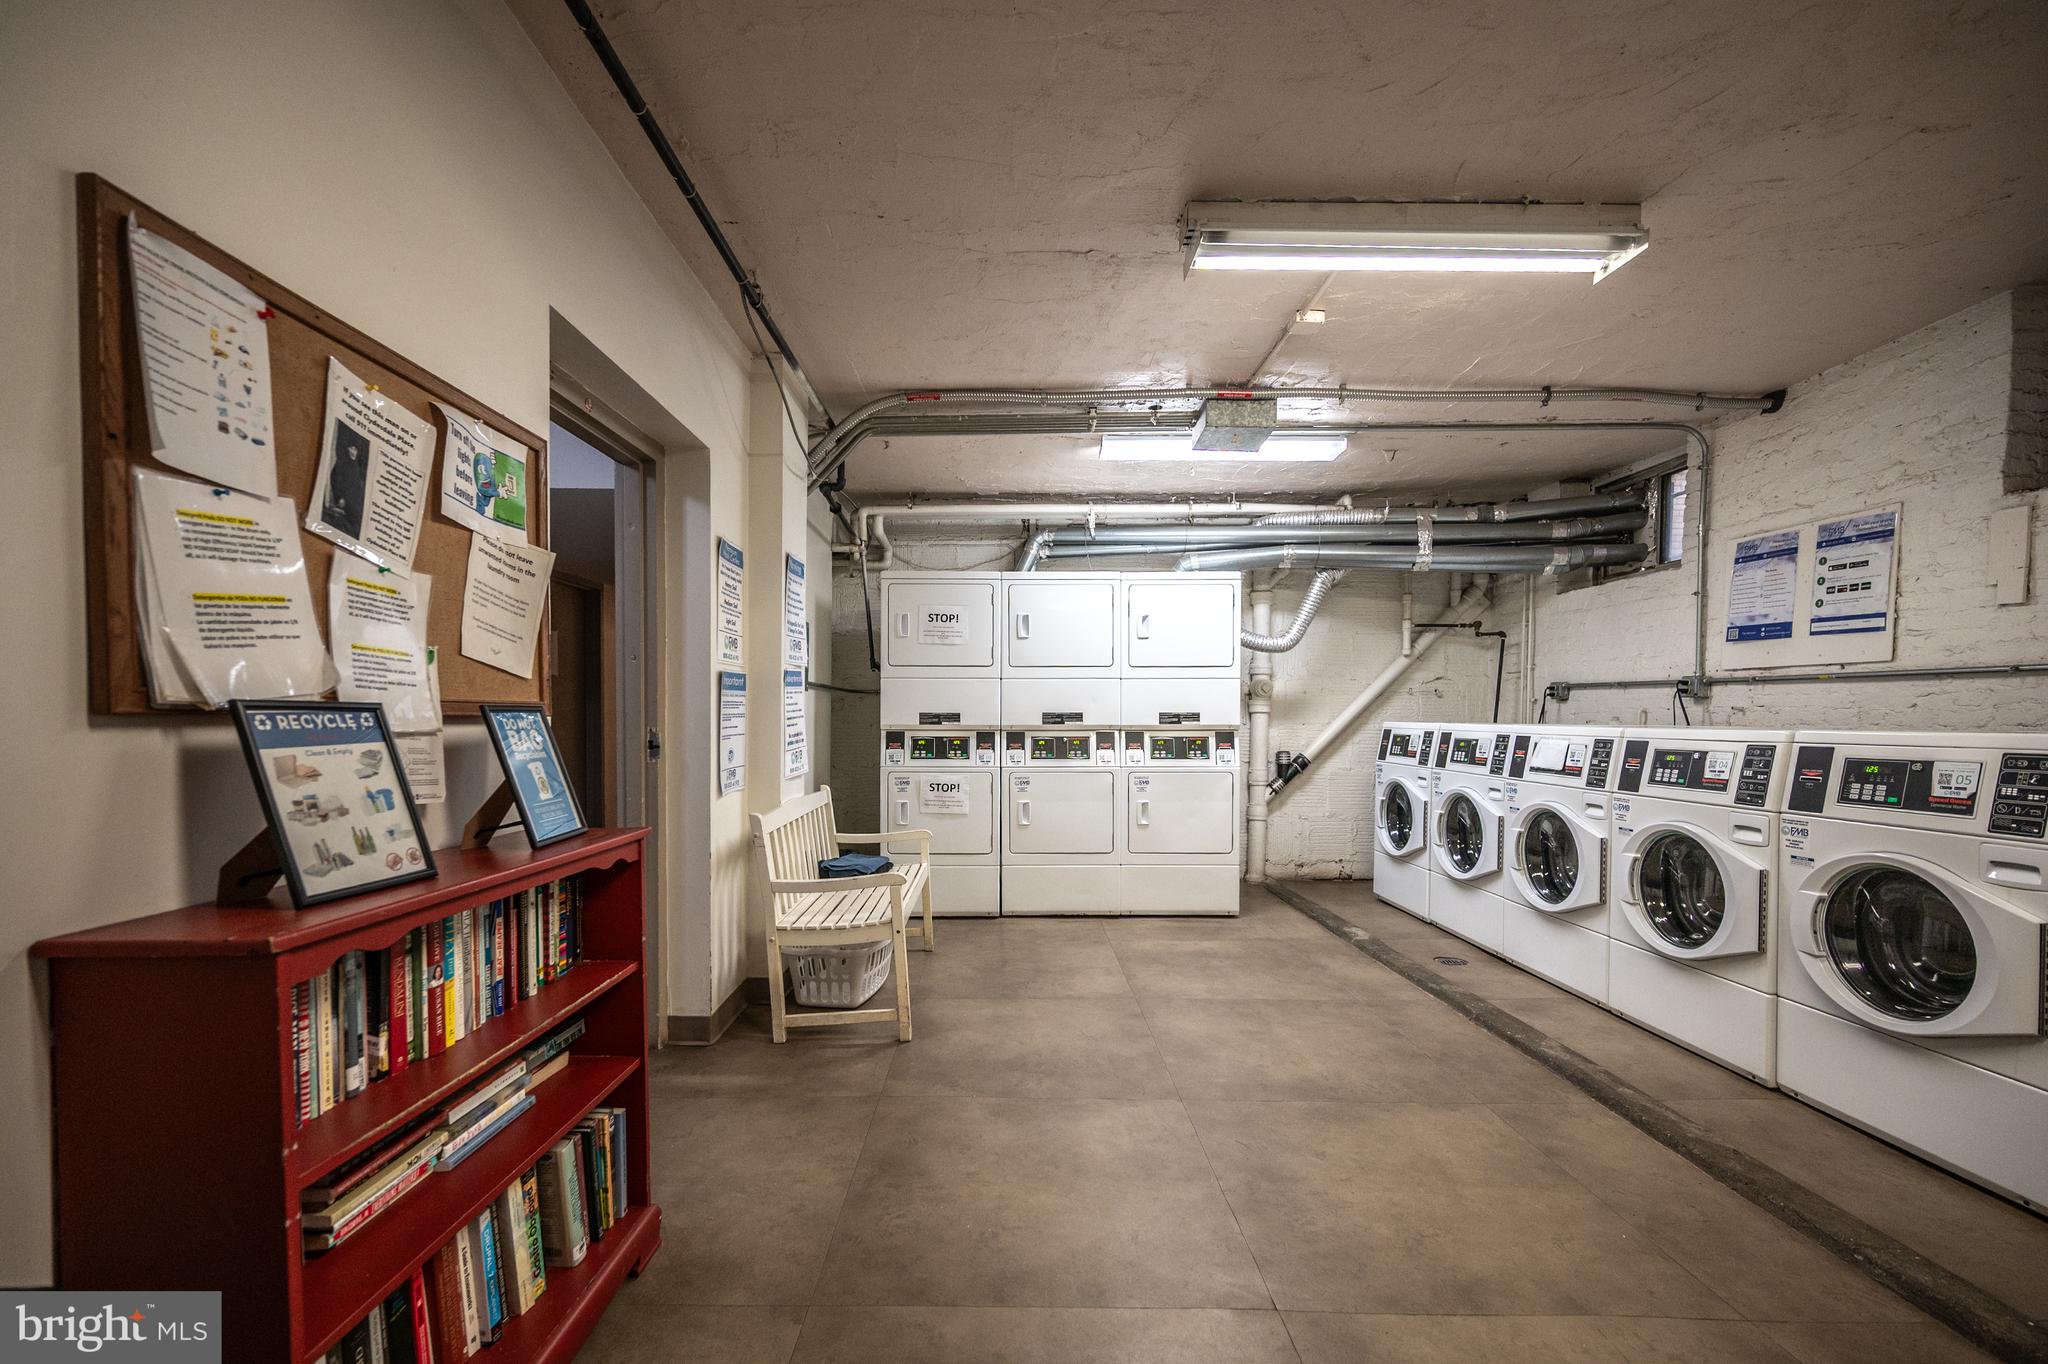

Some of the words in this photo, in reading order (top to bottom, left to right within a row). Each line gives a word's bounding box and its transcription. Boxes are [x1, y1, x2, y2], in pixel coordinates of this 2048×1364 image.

[342, 398, 362, 415] around
[372, 409, 384, 420] this
[385, 417, 400, 430] man
[367, 427, 409, 456] immediately!
[451, 422, 462, 441] Turn
[456, 464, 473, 486] before
[454, 482, 474, 506] leaving
[482, 535, 498, 550] Please
[504, 550, 516, 560] not
[516, 552, 534, 567] leave
[478, 546, 502, 564] unwanted
[517, 566, 524, 575] in
[525, 568, 536, 579] the
[487, 562, 506, 580] laundry
[506, 573, 520, 585] room
[928, 613, 959, 623] STOP!
[275, 713, 357, 730] RECYCLE
[502, 718, 517, 730] DO
[304, 749, 326, 758] Clean
[929, 783, 960, 793] STOP!
[1955, 774, 1972, 786] 05
[1790, 826, 1809, 837] FMB
[434, 941, 442, 963] LOVE
[463, 932, 472, 976] Handbook
[393, 955, 405, 1018] KUNDALINI
[434, 987, 442, 1014] SUSAN
[435, 1015, 443, 1036] RICE
[482, 1228, 494, 1271] DRUPAL
[532, 1238, 542, 1278] Gastro
[464, 1273, 473, 1311] Econometrics
